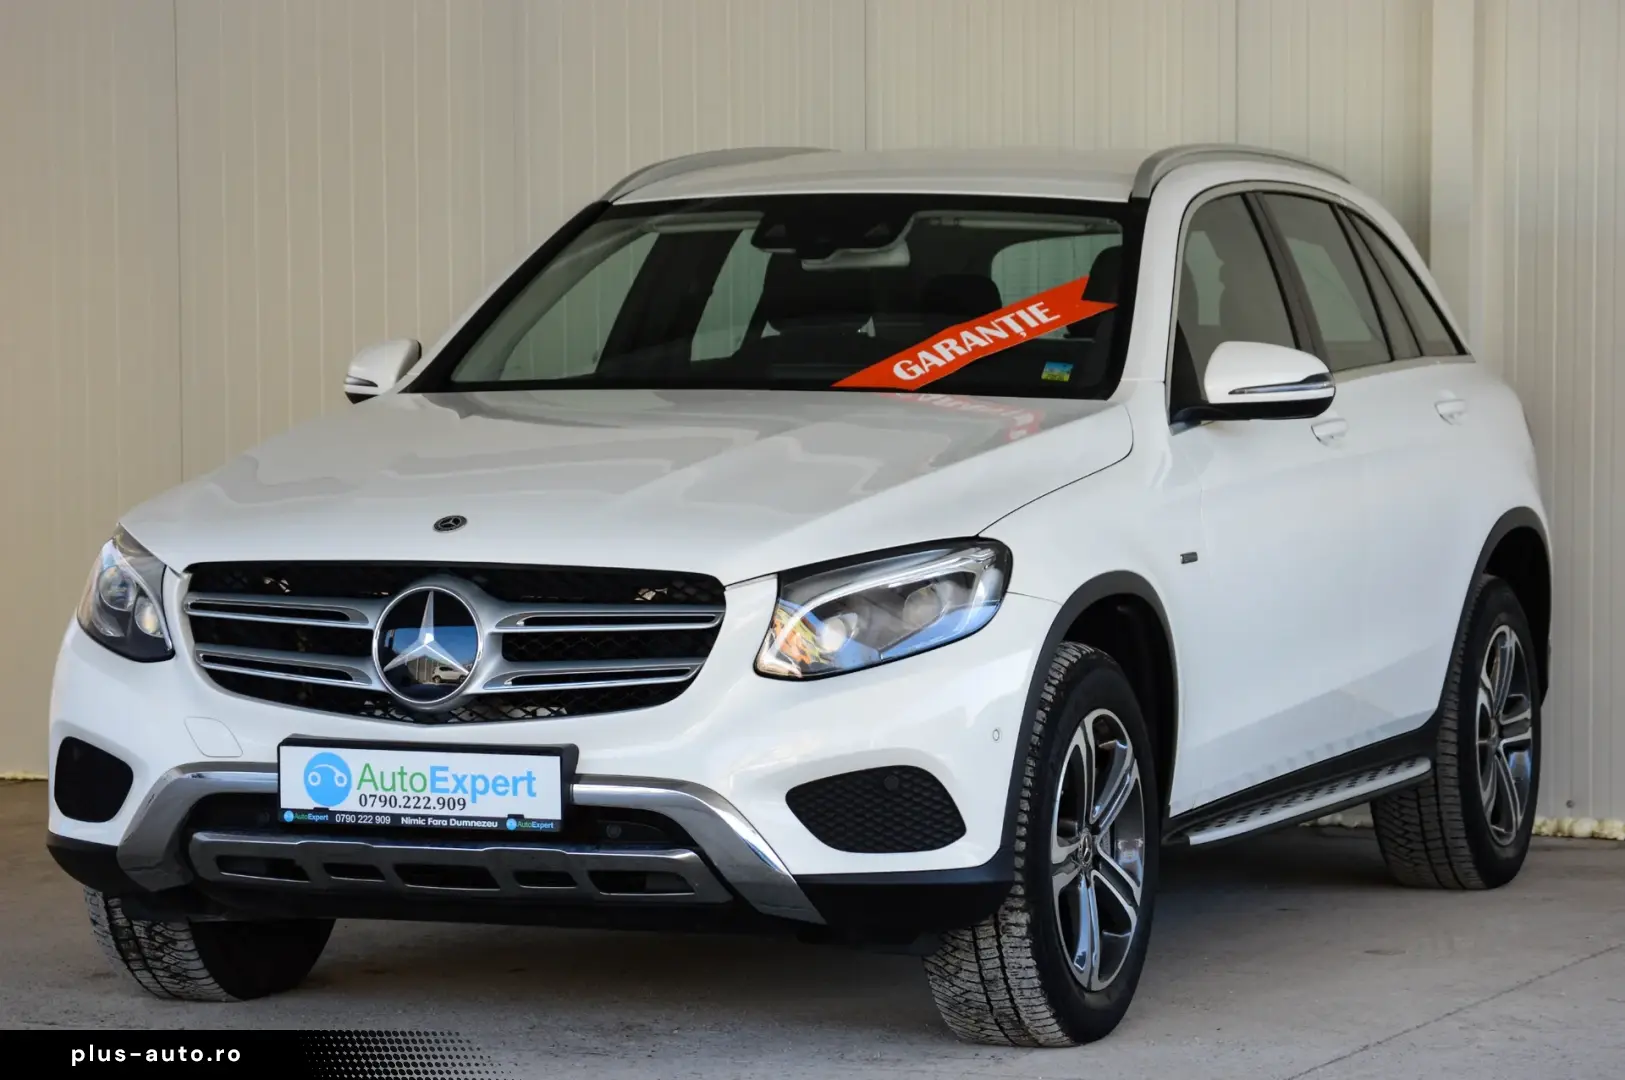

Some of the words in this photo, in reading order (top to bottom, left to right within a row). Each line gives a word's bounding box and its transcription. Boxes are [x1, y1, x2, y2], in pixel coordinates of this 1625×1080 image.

[357, 762, 537, 803] AutoExpert
[358, 793, 467, 811] 0790.222.909
[293, 812, 329, 822] AutoExpert
[335, 813, 356, 823] 0790
[357, 814, 374, 824] 222
[375, 815, 391, 825] 909
[400, 816, 426, 826] Nimic
[427, 817, 448, 827] Fara
[449, 818, 499, 828] Dumnezeu
[516, 820, 554, 830] AutoExpert
